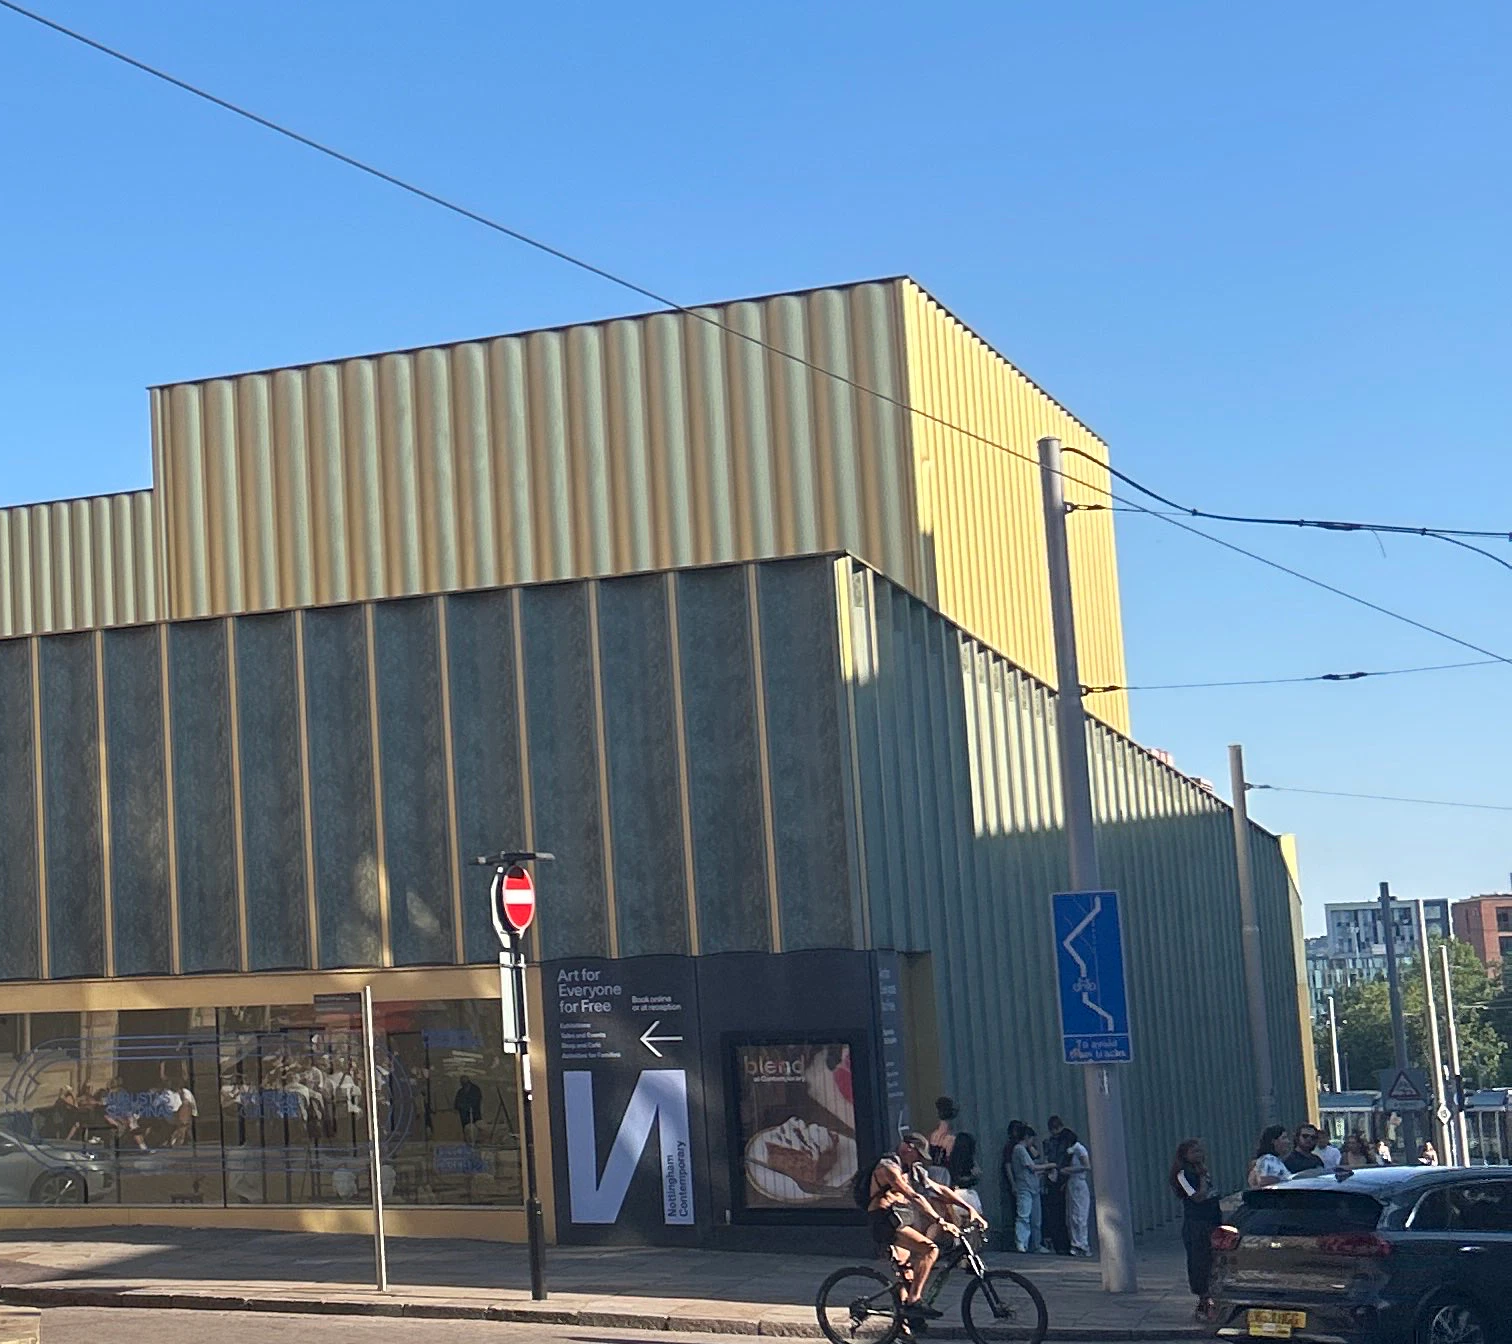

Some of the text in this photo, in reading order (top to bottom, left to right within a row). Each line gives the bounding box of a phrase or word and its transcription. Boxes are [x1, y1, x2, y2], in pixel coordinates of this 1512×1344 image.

[557, 968, 600, 982] Art for
[558, 984, 622, 998] Everyone
[560, 999, 612, 1013] for Free
[744, 1055, 805, 1075] blend
[666, 1154, 678, 1217] Nottingham
[677, 1140, 689, 1217] Contemporary
